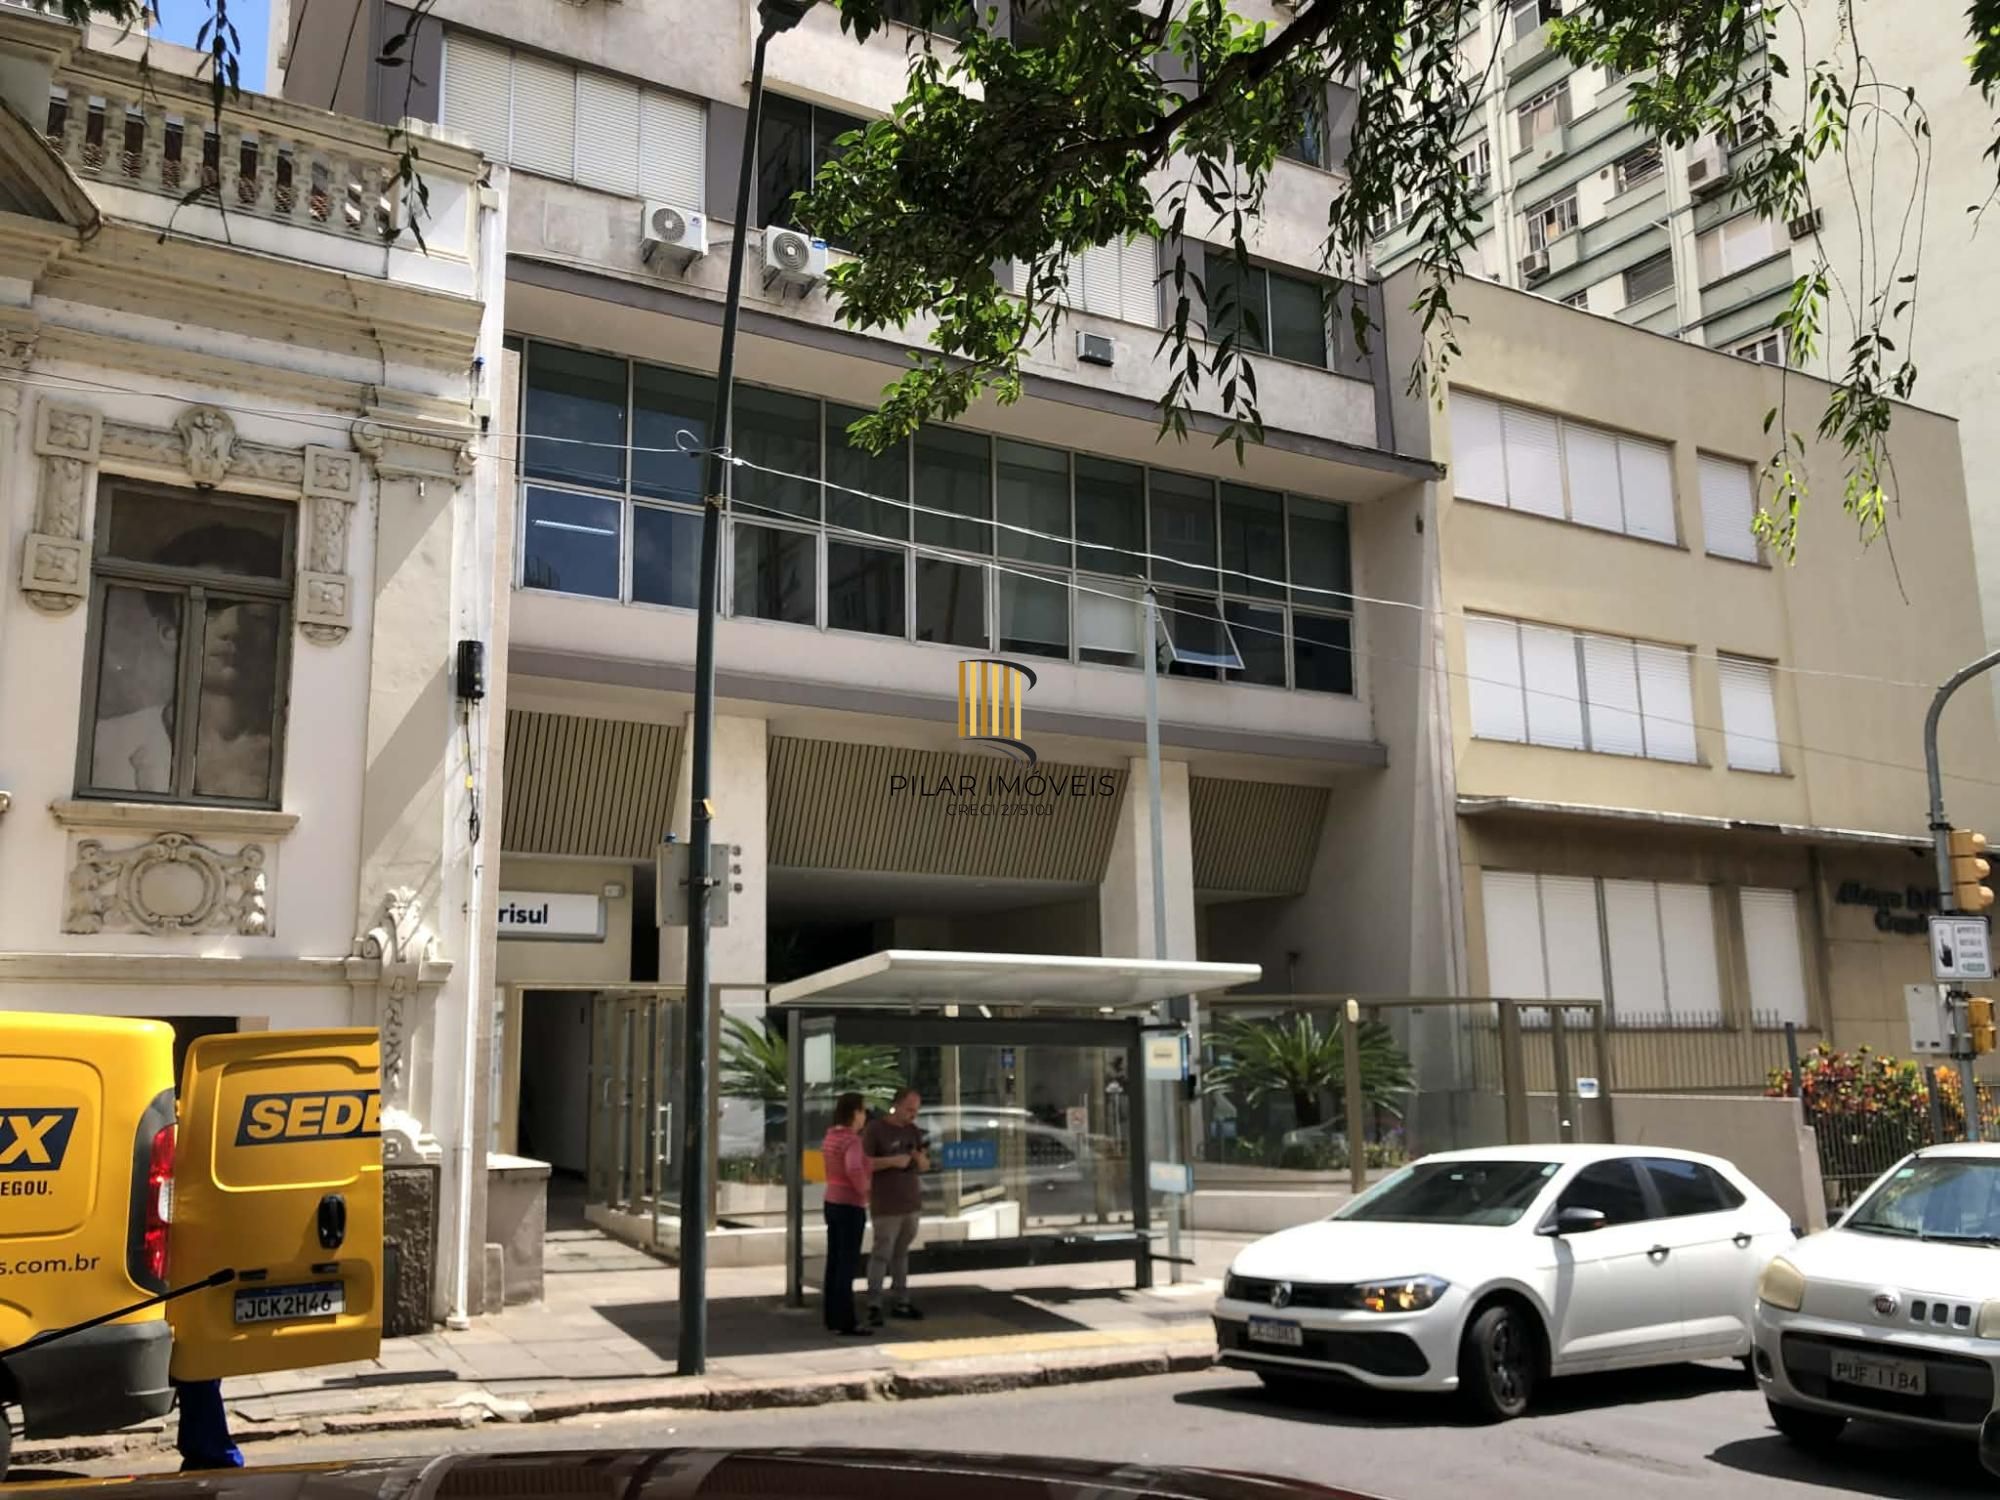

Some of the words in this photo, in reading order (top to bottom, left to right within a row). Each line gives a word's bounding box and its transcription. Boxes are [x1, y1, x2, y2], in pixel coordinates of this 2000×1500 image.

[498, 902, 548, 924] risul
[0, 1114, 63, 1165] X
[244, 1293, 332, 1319] JCK2H46
